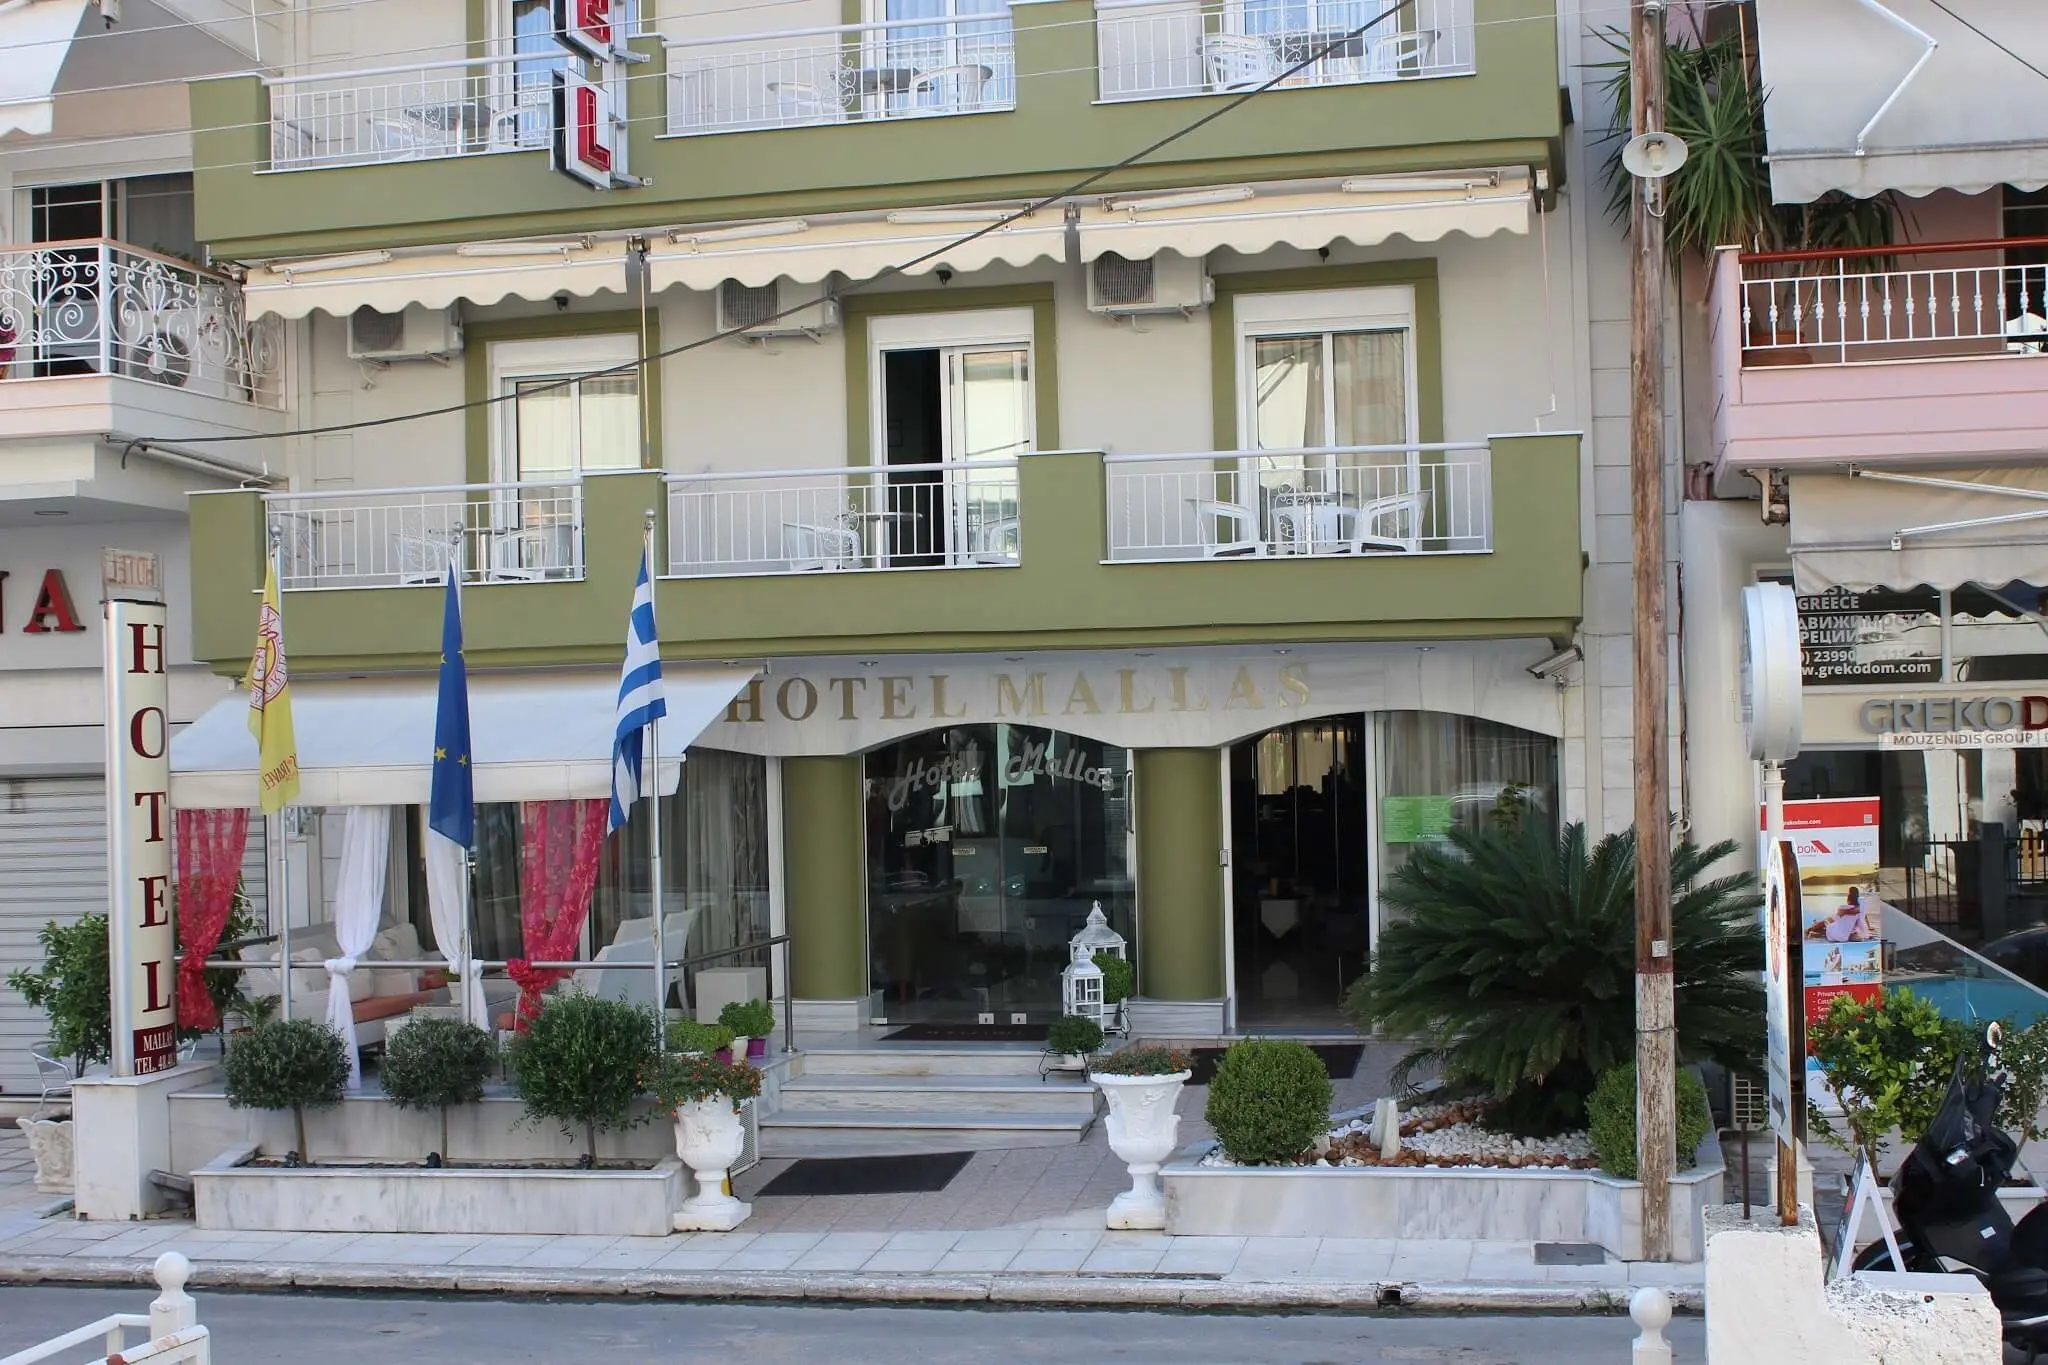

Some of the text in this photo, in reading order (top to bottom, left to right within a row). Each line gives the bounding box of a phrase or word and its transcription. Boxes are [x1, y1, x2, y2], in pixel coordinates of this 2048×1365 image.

[0, 568, 87, 634] A
[1797, 596, 1860, 611] GREECE
[1801, 663, 1932, 679] w.grekodom.com
[723, 662, 1311, 723] HOTEL MALLAS
[1860, 695, 2048, 733] GREKOD
[1893, 732, 2034, 746] MOUZENIDIS GROUP
[127, 623, 171, 1013] HOTEL
[143, 1030, 173, 1052] MALLAS
[135, 1056, 157, 1074] TEL.
